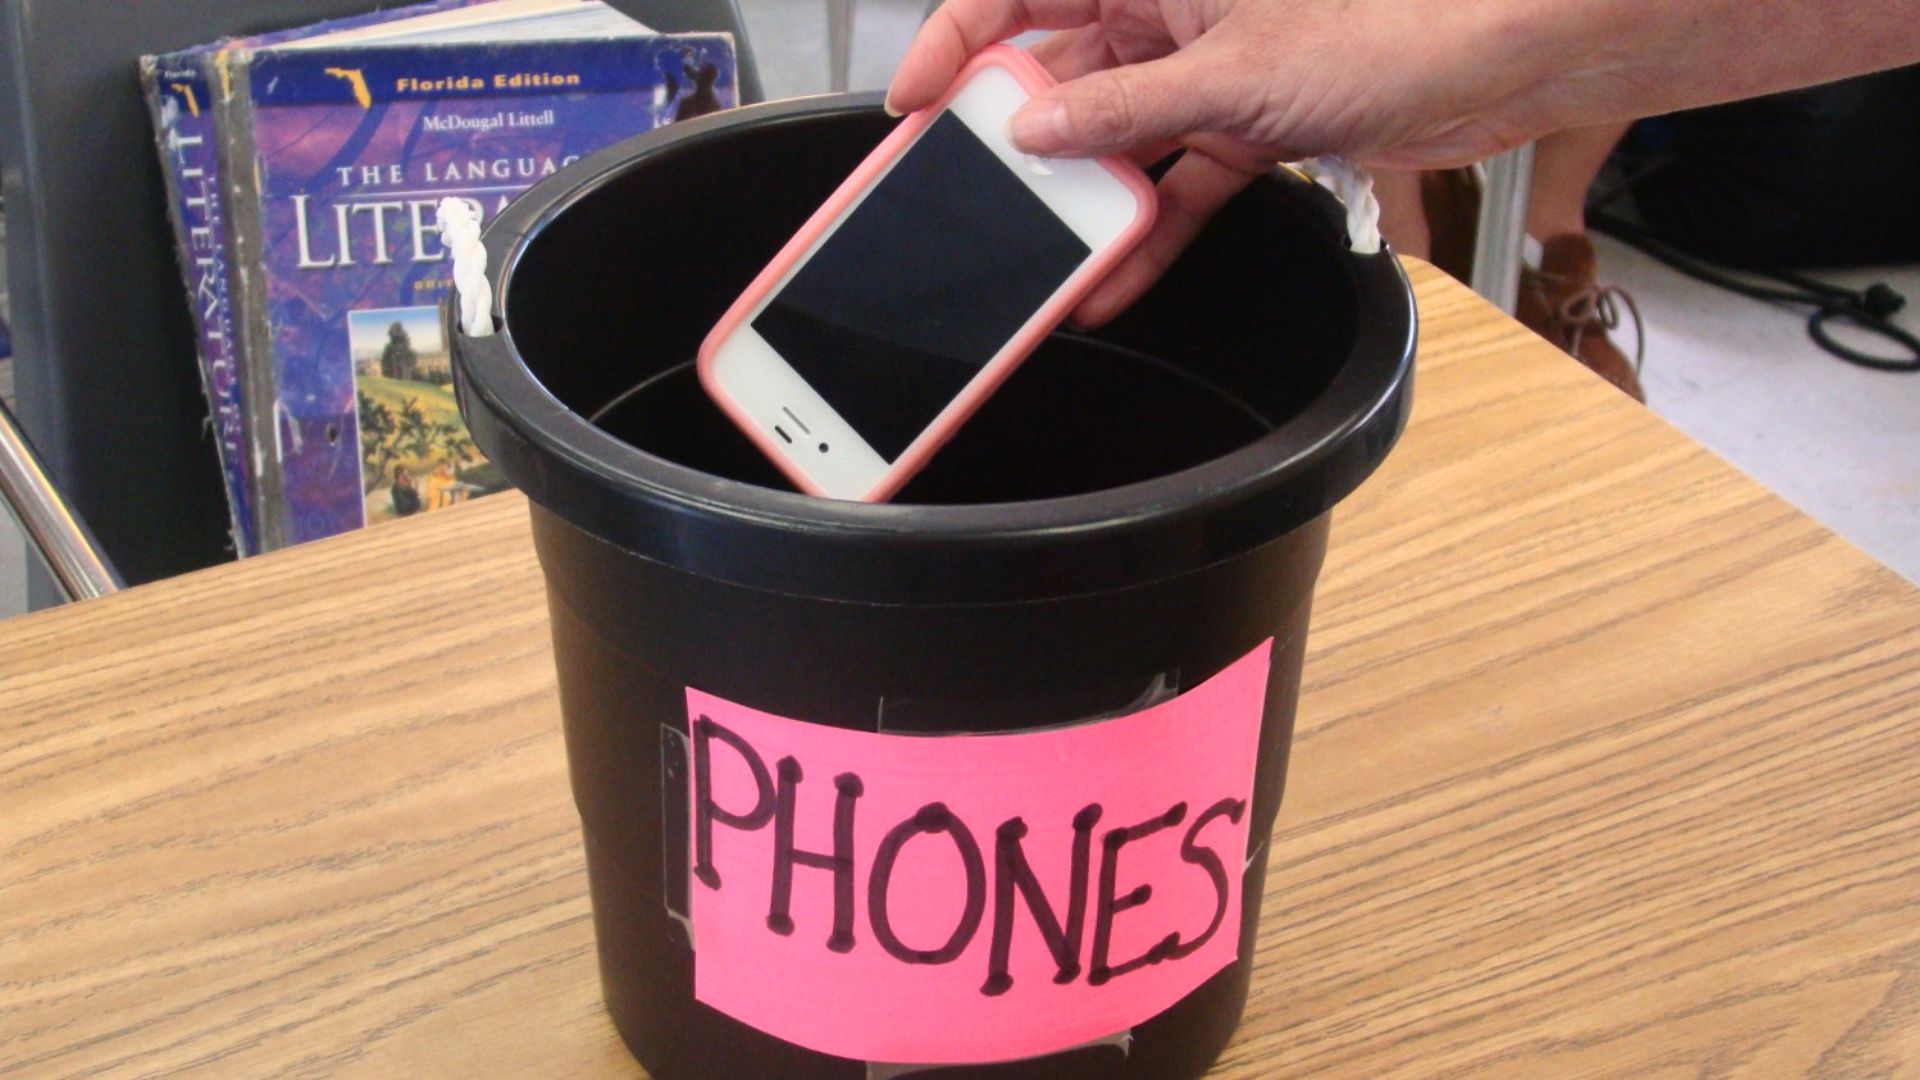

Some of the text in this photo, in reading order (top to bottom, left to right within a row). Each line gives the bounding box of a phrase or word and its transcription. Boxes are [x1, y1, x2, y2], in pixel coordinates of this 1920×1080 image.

[396, 73, 581, 92] Florida Edition
[423, 110, 555, 131] McDougal Littell
[336, 164, 403, 186] THE
[289, 193, 509, 268] LITE
[692, 714, 1247, 997] PHONES
